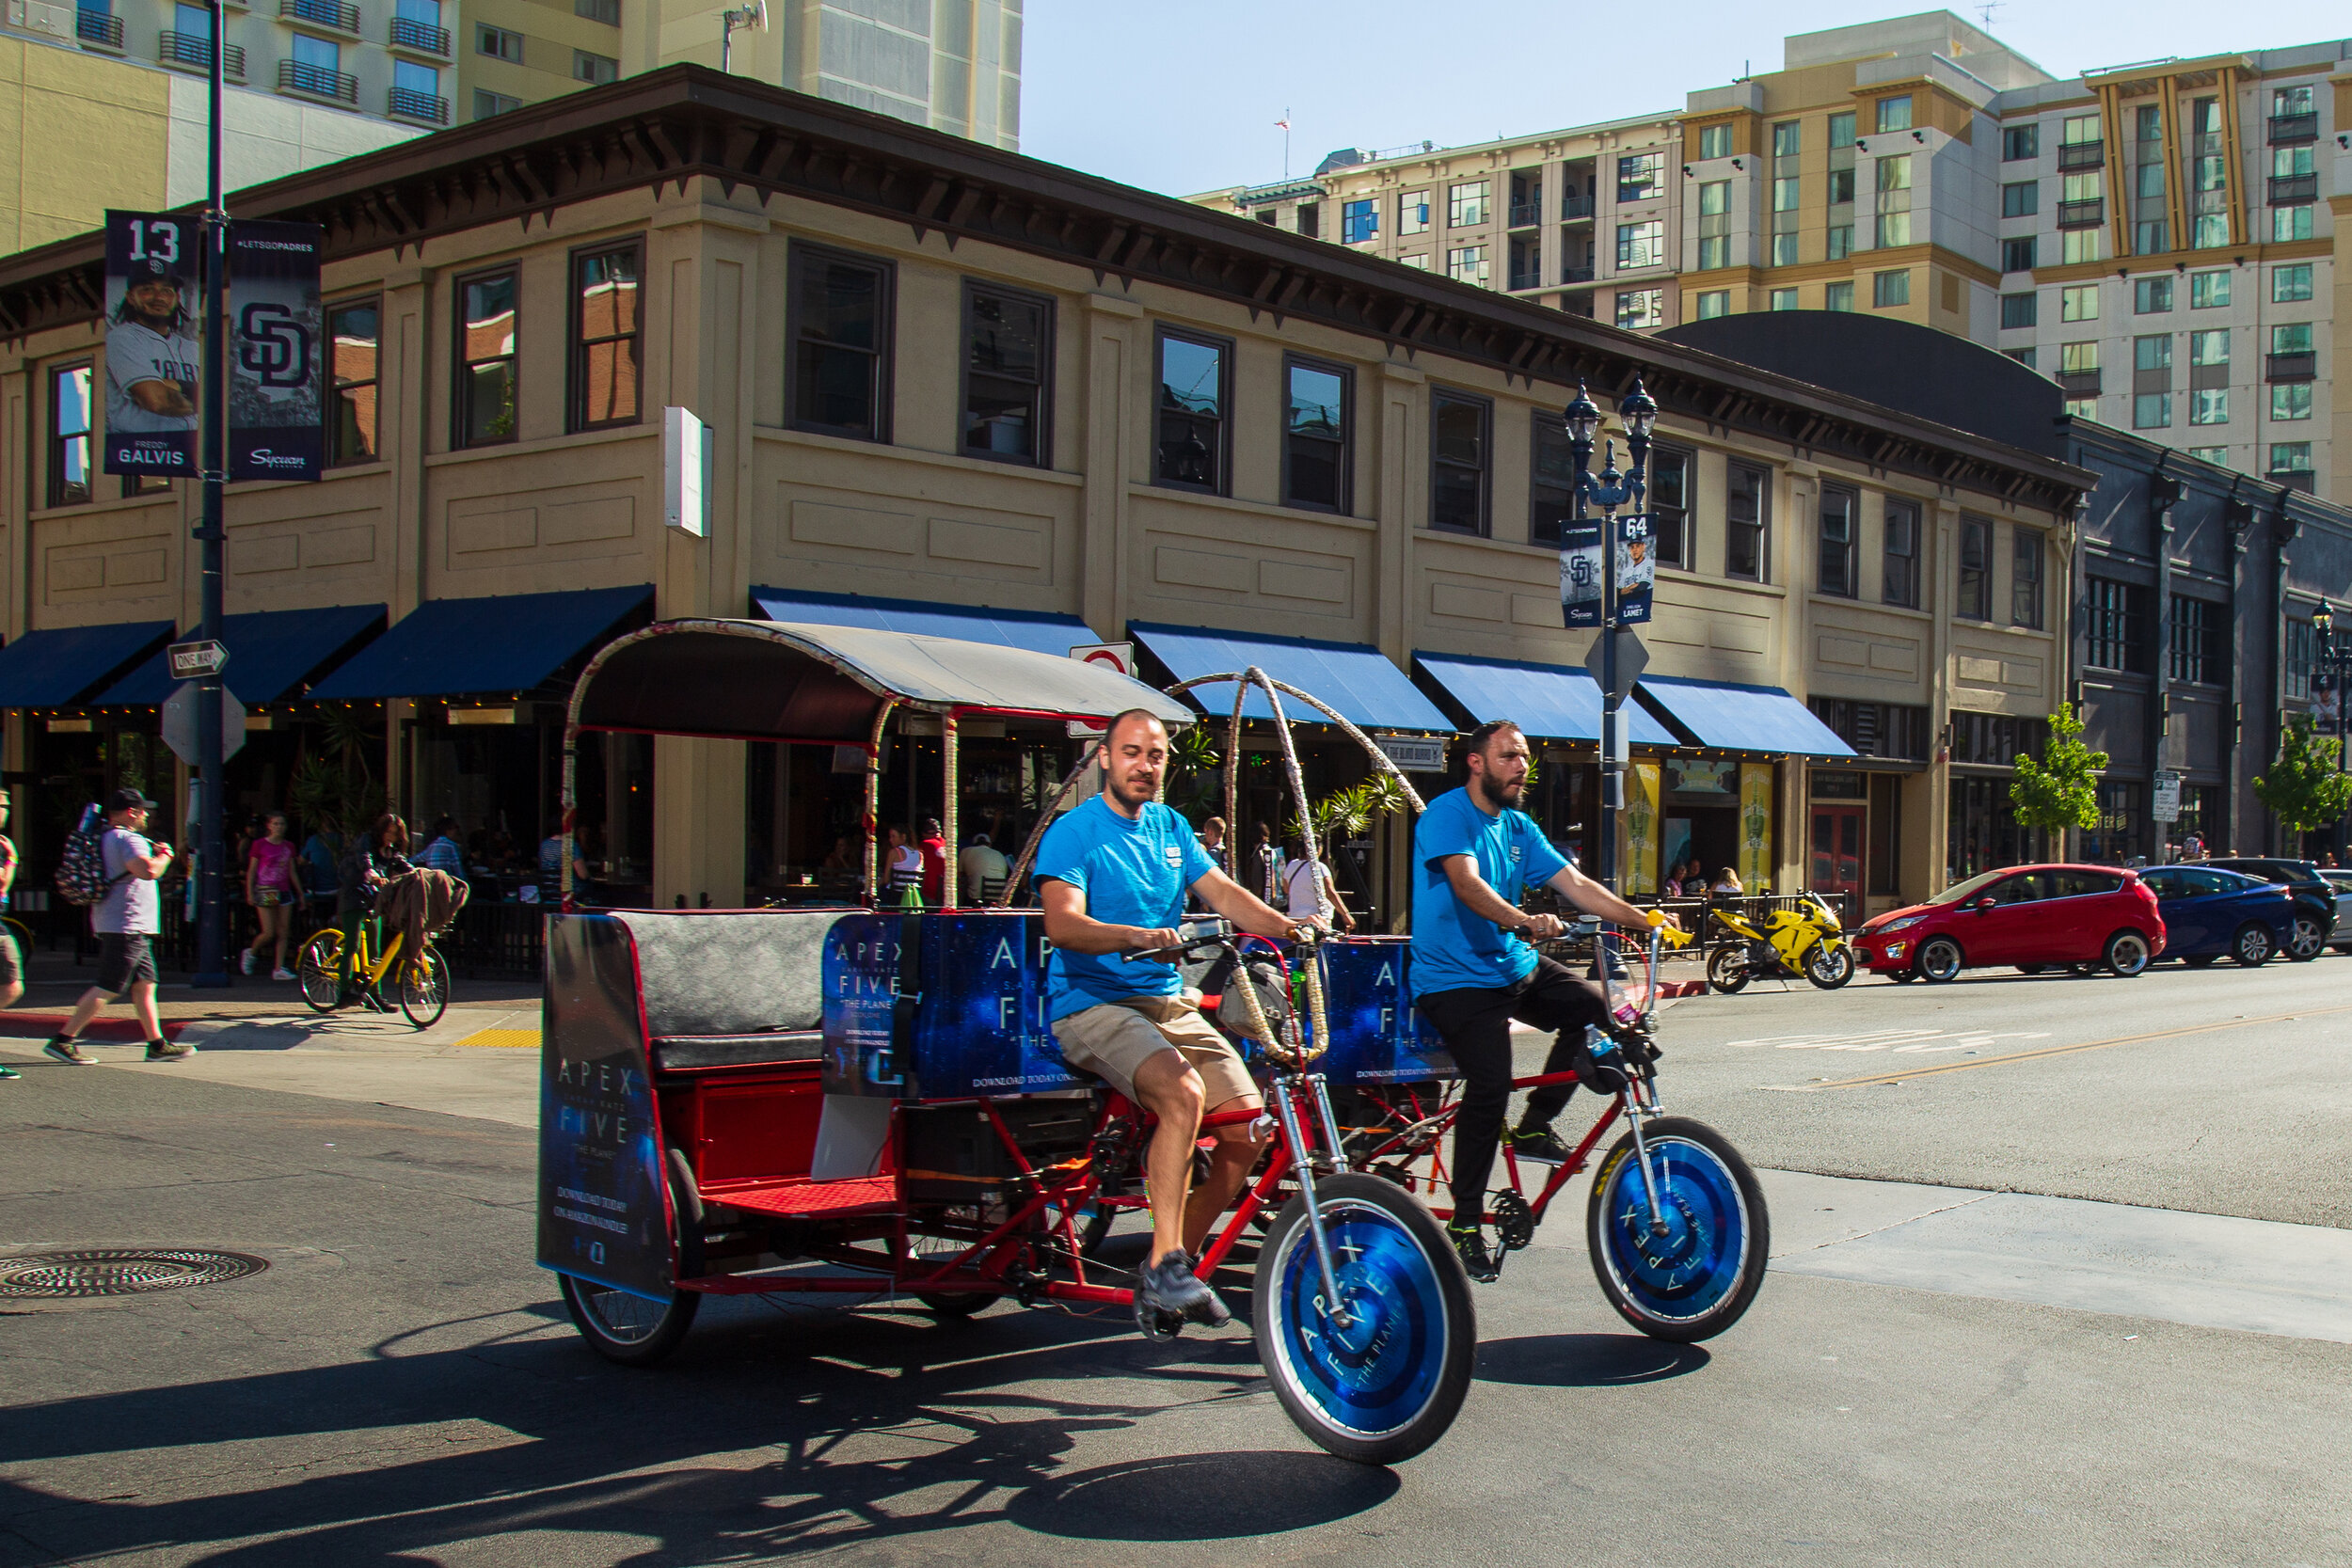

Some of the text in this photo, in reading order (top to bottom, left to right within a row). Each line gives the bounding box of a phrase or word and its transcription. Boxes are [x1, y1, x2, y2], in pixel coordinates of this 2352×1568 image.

[130, 220, 180, 263] 13
[237, 240, 314, 253] #LETSGOPADRES
[241, 302, 310, 388] SD
[135, 439, 169, 450] FREDDY
[119, 449, 184, 466] GALVIS
[249, 449, 306, 469] Sycuan
[1626, 517, 1646, 537] 64
[1570, 555, 1591, 588] SD
[1623, 610, 1644, 618] LAMET
[177, 653, 196, 668] ONE
[839, 975, 901, 996] FIVE
[558, 1057, 633, 1097] APEX
[973, 1075, 1025, 1087] DOWNLOAD
[560, 1104, 628, 1145] FIVE
